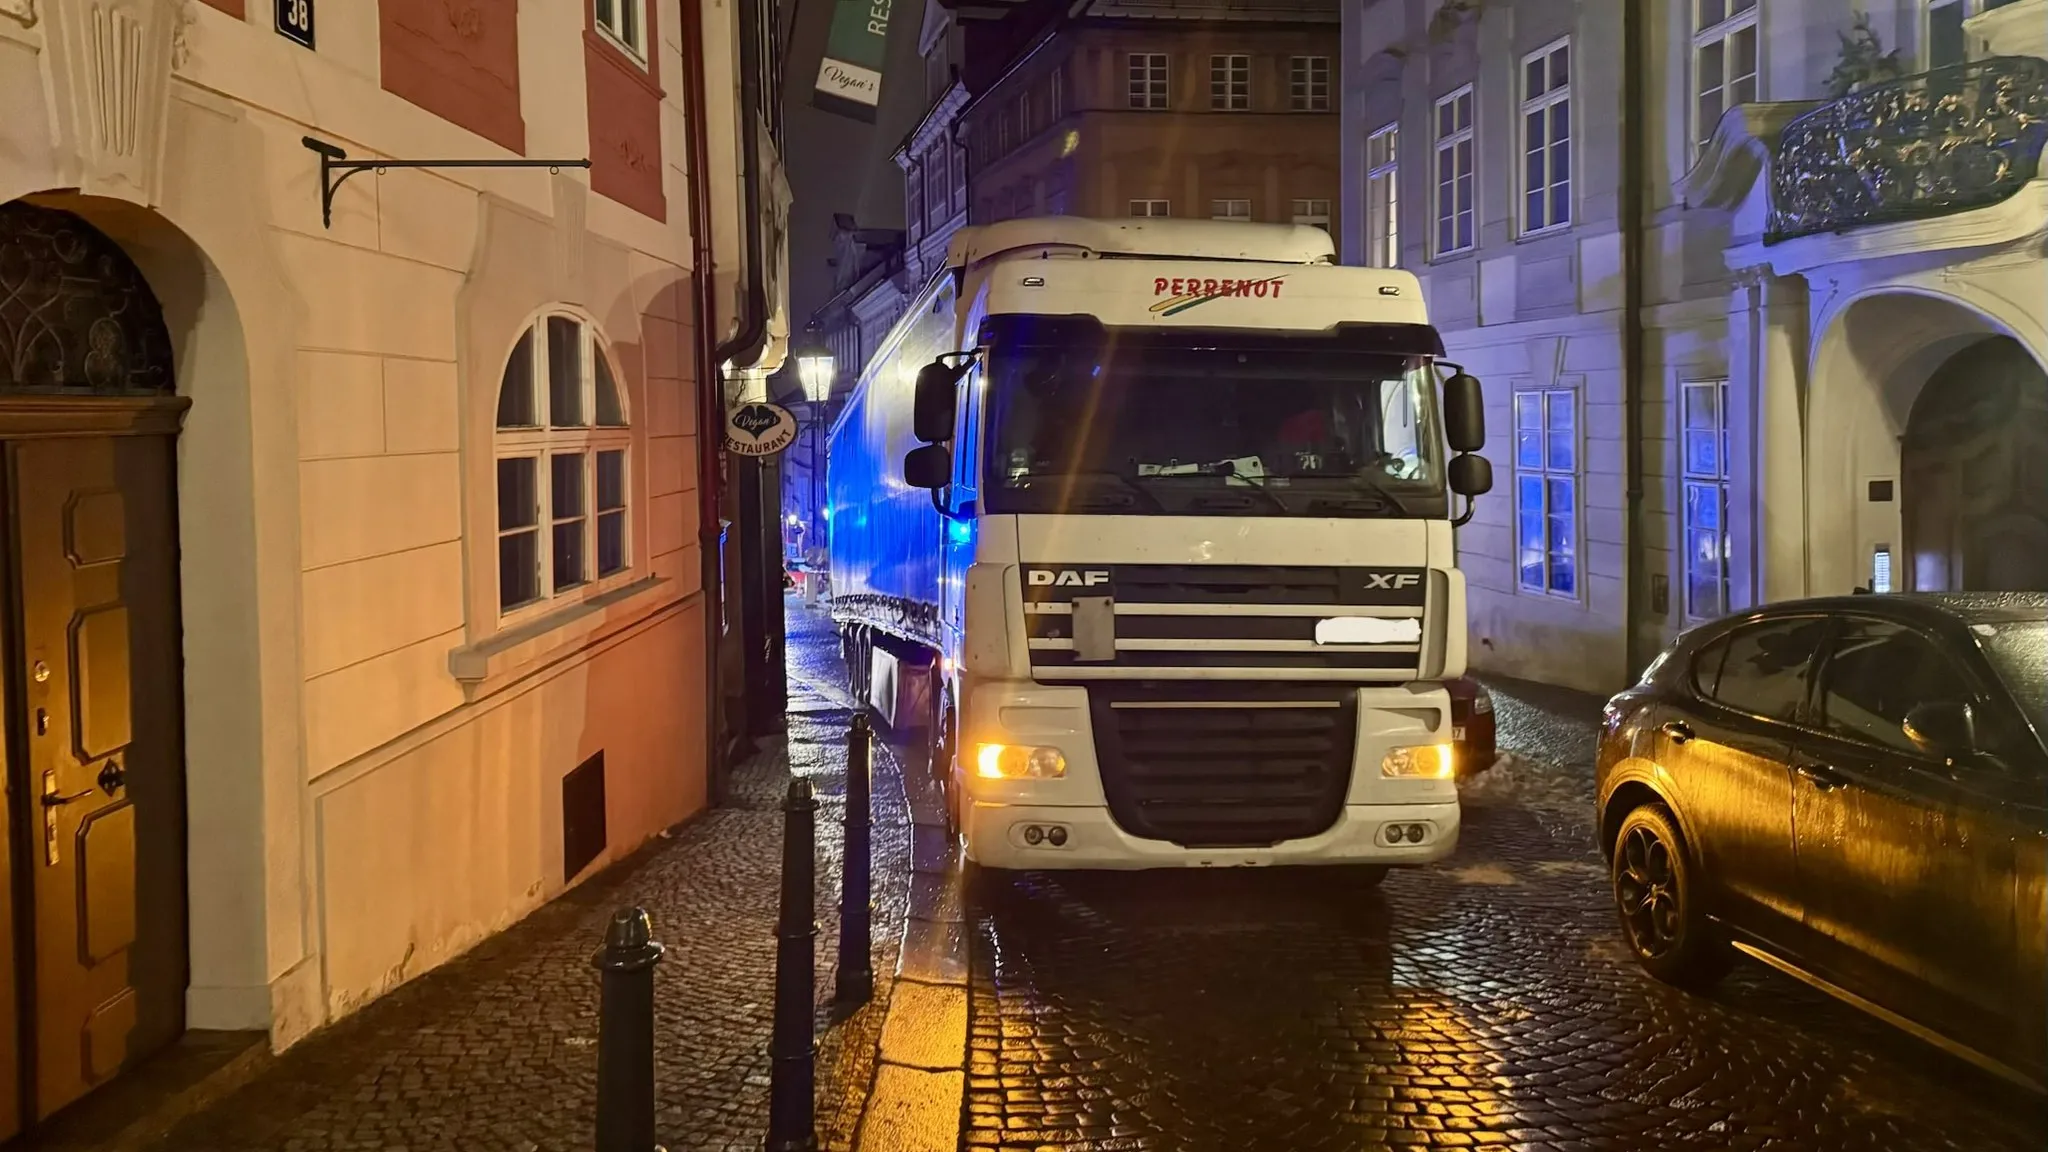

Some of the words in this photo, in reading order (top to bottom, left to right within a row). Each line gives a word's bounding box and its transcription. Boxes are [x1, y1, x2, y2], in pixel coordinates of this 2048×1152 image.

[288, 0, 308, 31] 38
[824, 66, 874, 91] Vegan's
[1154, 278, 1283, 298] PERRENOT
[1028, 570, 1109, 586] DAF
[1363, 573, 1420, 589] XF
